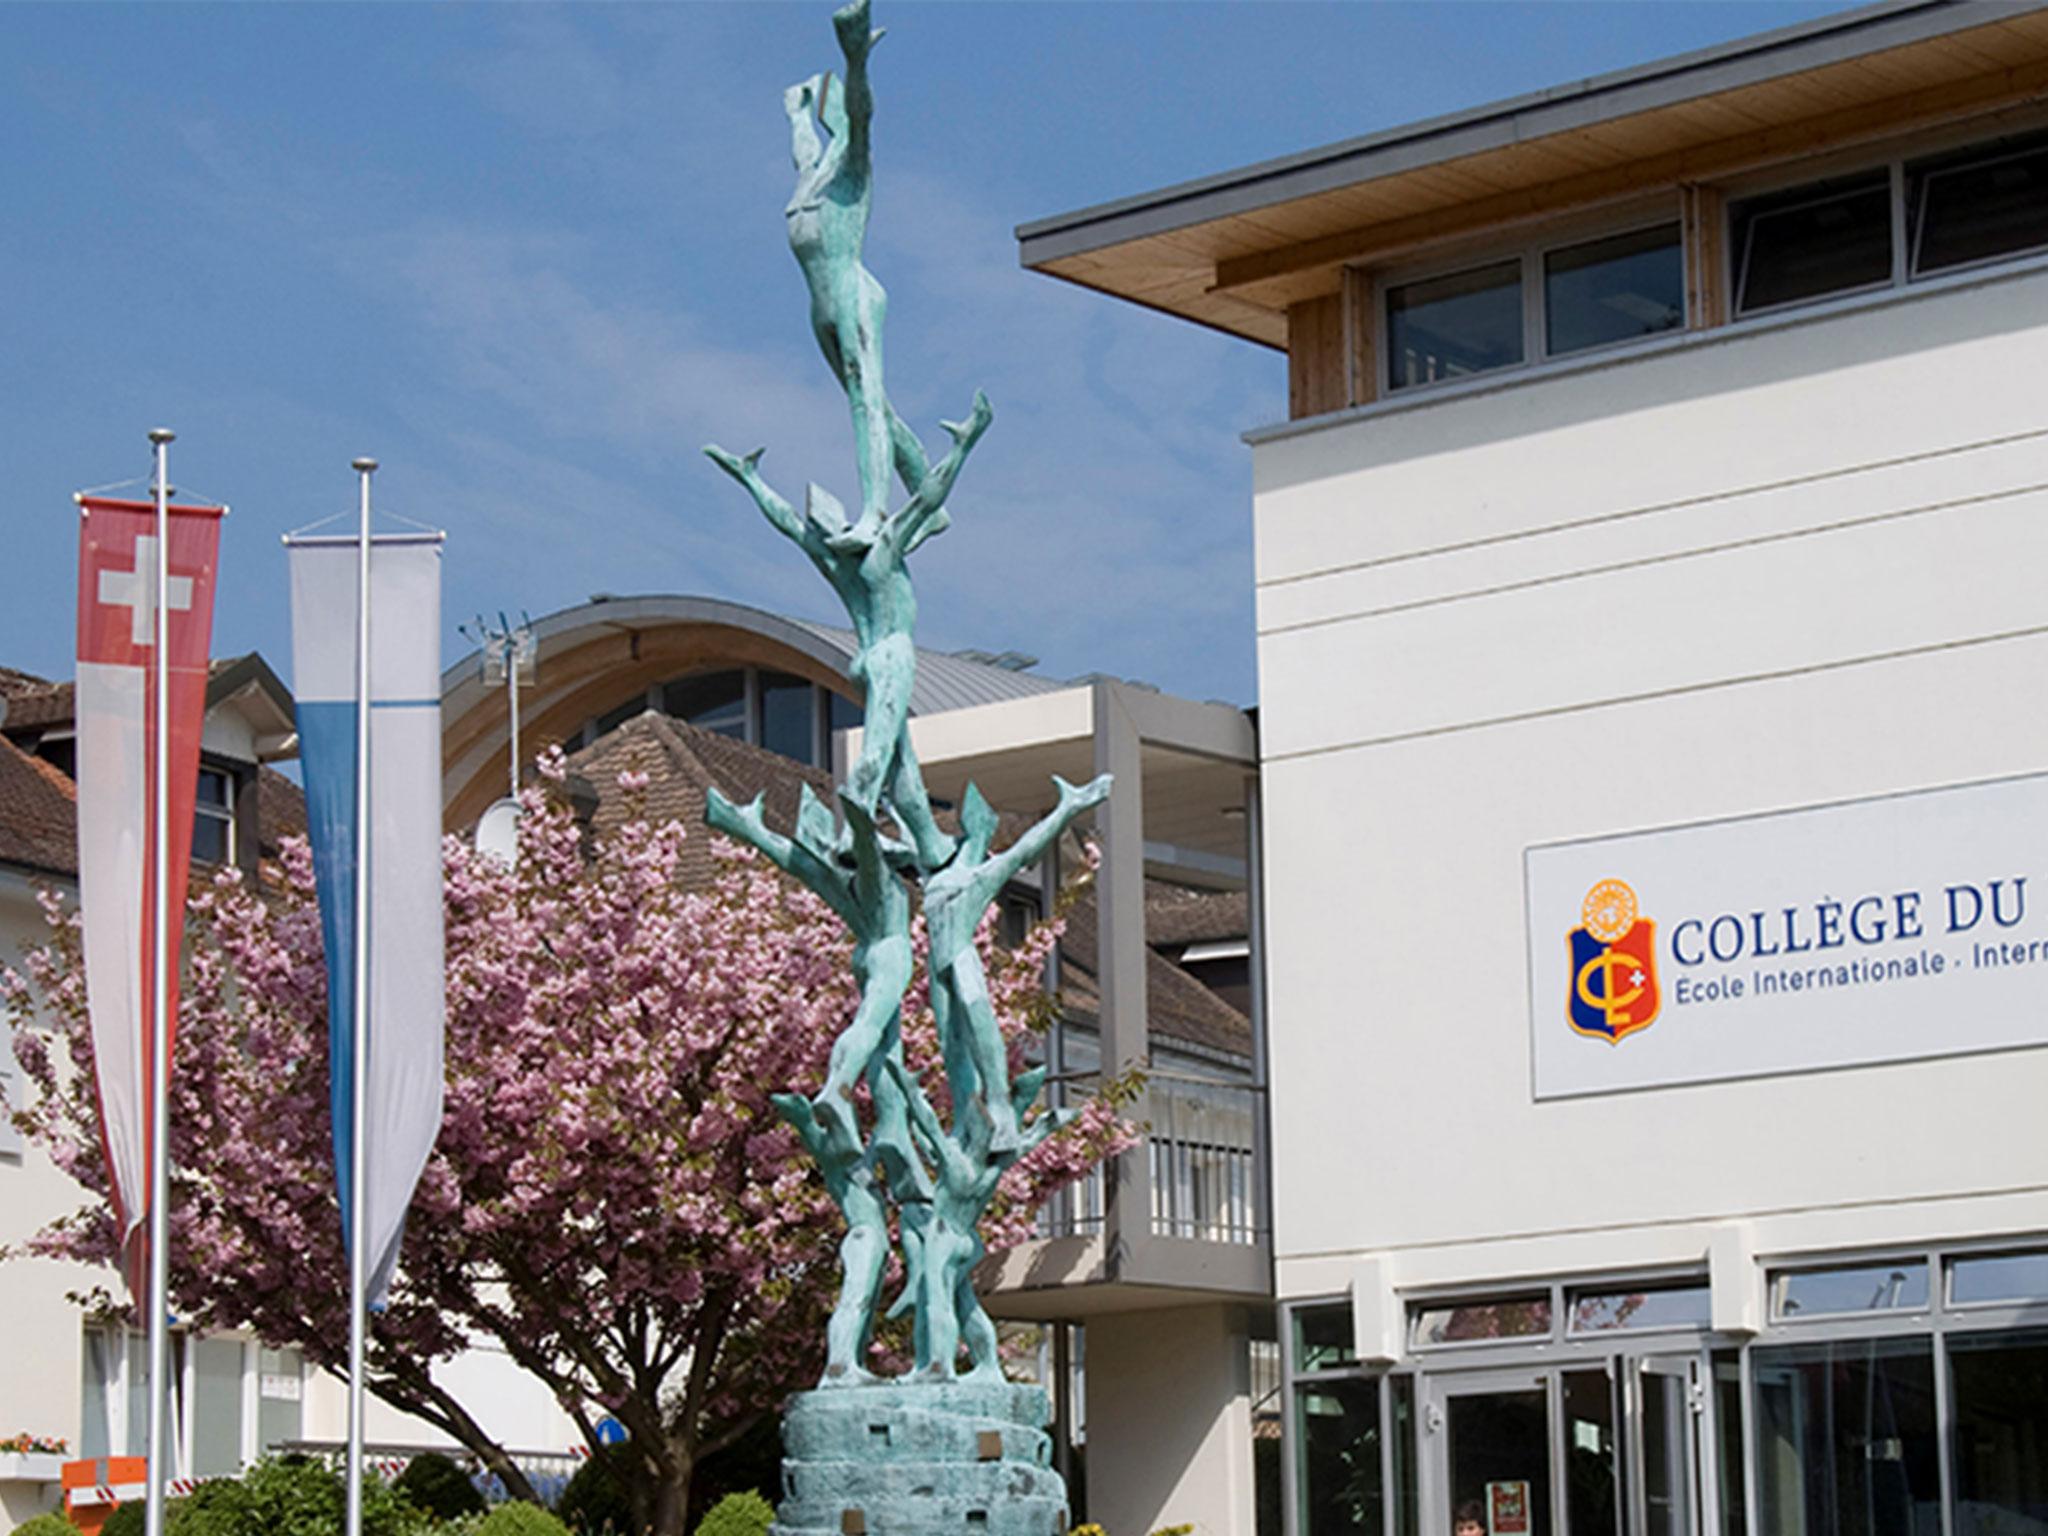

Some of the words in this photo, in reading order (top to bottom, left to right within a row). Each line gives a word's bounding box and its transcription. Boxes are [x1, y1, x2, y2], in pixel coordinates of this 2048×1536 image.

[1672, 892, 1923, 966] COLLÈGE
[1944, 878, 2027, 934] DU
[1753, 950, 1945, 996] Internationale
